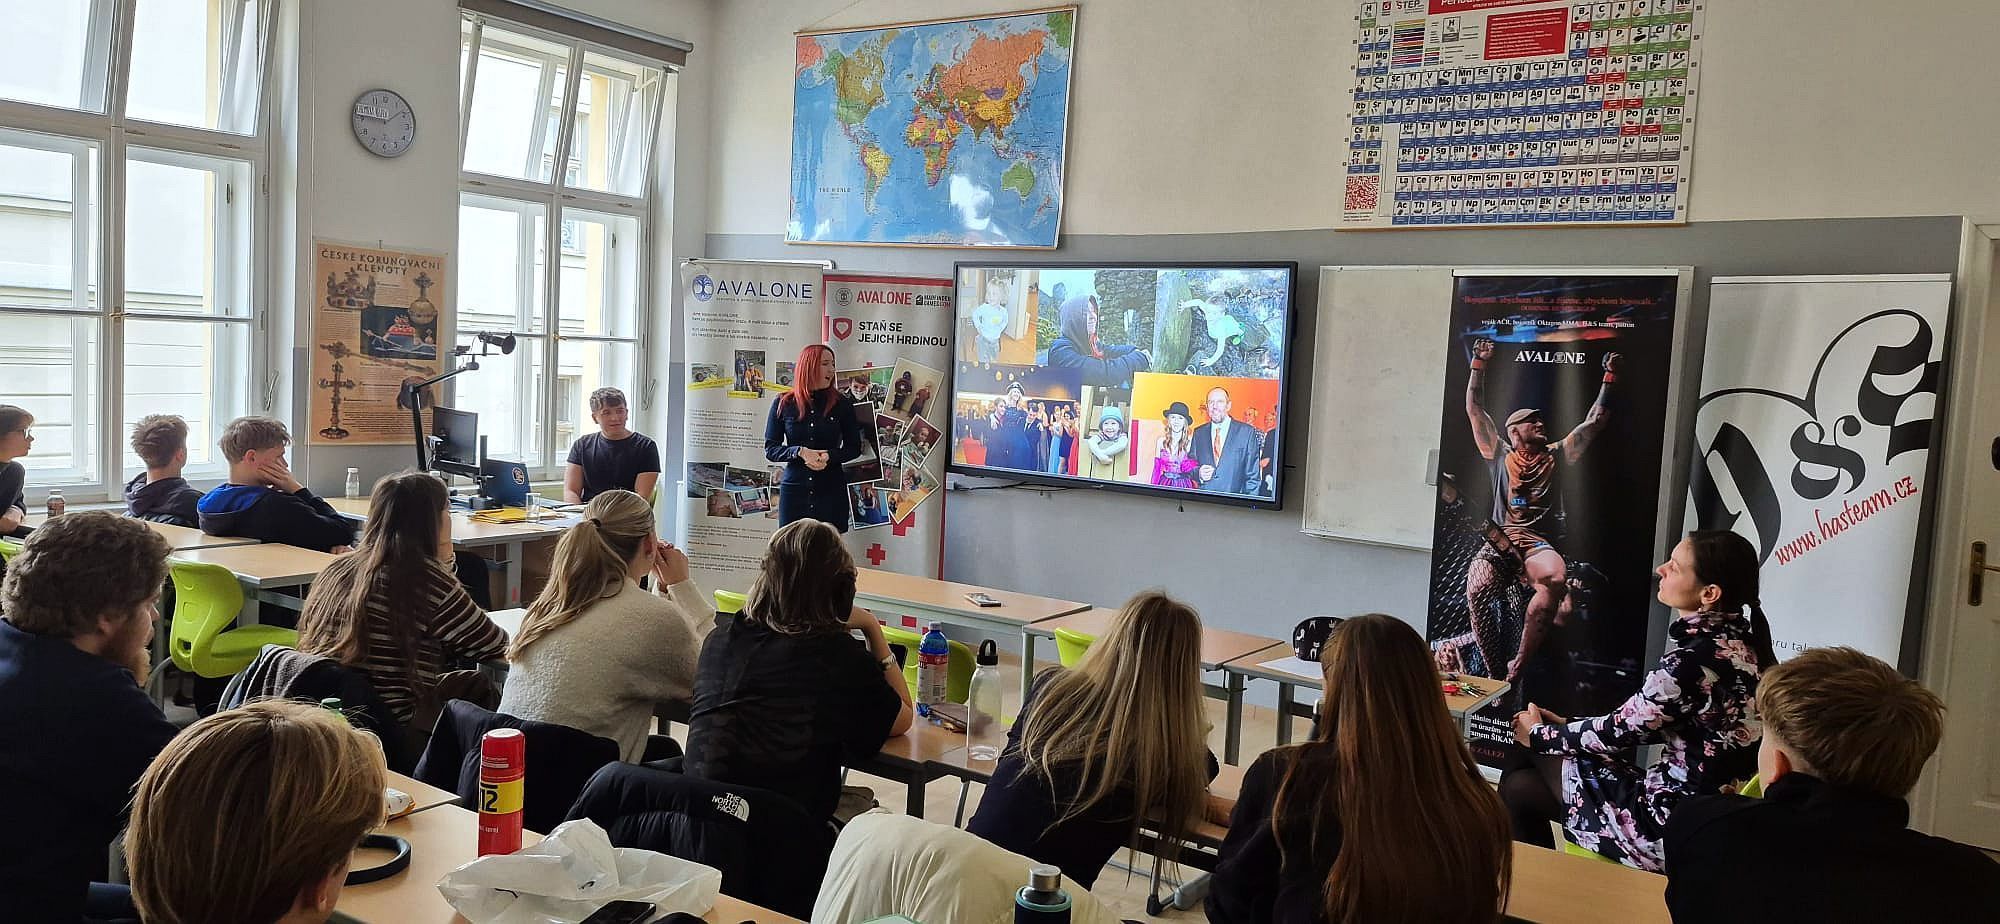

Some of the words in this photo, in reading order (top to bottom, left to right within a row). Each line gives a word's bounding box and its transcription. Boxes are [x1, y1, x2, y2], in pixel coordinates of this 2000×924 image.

[1531, 90, 1542, 98] Ag
[1547, 114, 1559, 123] Hg
[1527, 142, 1538, 150] Rg
[1562, 171, 1573, 179] Dy
[1466, 200, 1477, 208] Np
[321, 248, 357, 261] ČESKÉ
[360, 254, 441, 270] KORUNOVAČNÍ
[356, 264, 408, 276] KLENOTY
[716, 280, 813, 298] AVALONE
[856, 290, 912, 306] AVALONE
[858, 320, 887, 332] STAŇ
[889, 322, 903, 332] SE
[858, 333, 894, 344] JEJICH
[896, 334, 948, 346] HRDINOU
[1775, 476, 1918, 566] www.hasteam.cz
[712, 795, 739, 810] NORTH
[726, 792, 742, 802] THE
[716, 804, 736, 816] FACE
